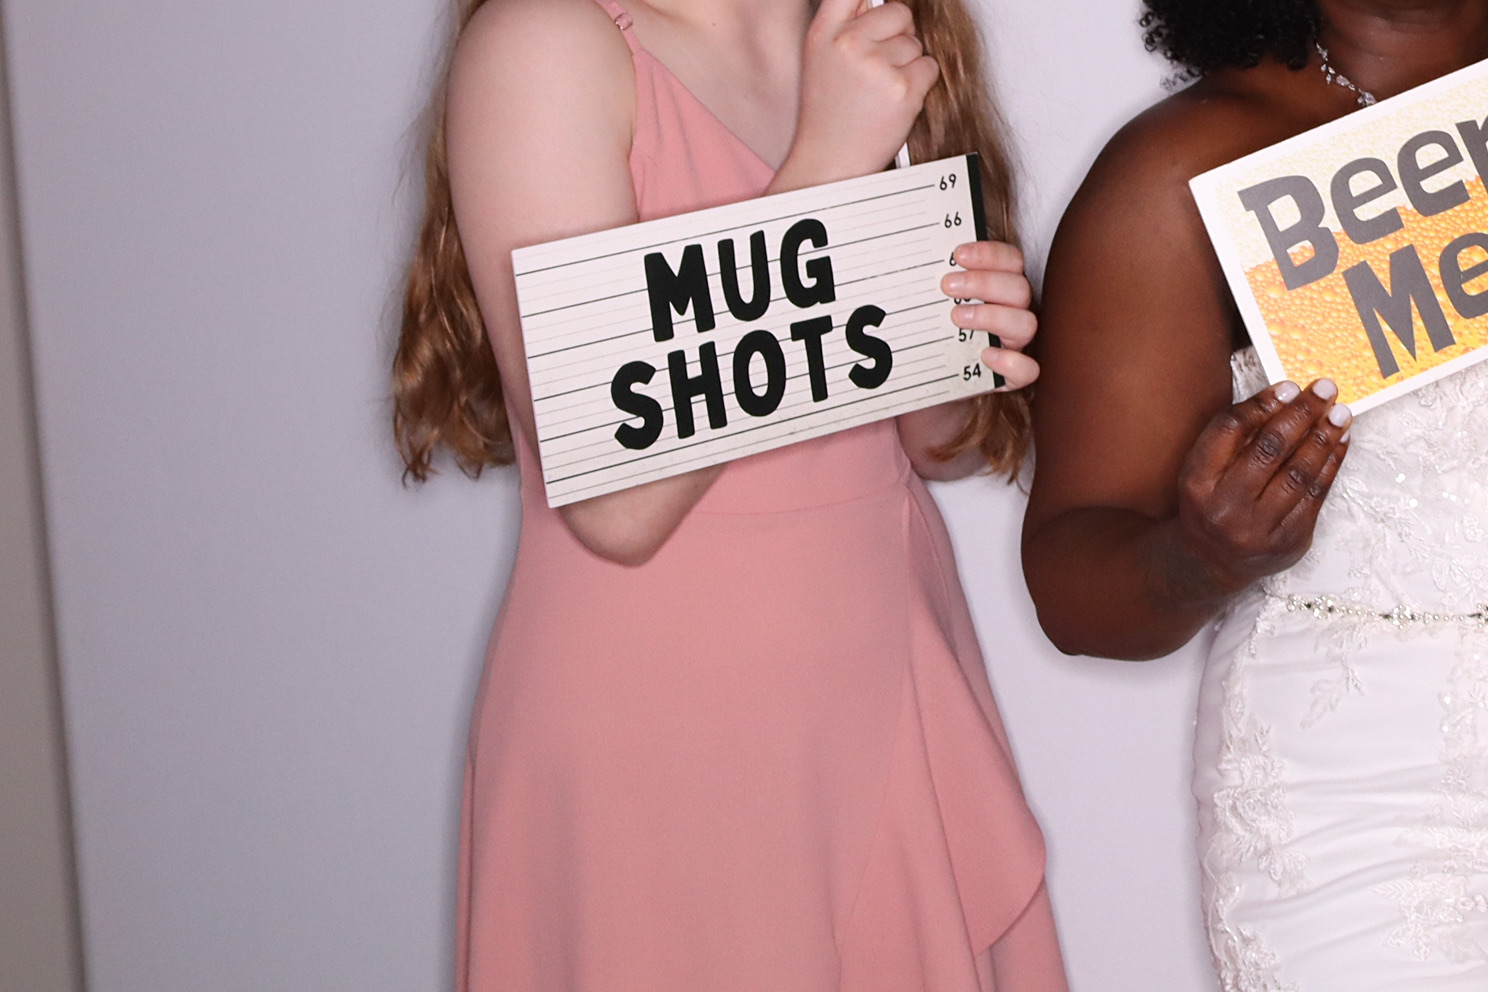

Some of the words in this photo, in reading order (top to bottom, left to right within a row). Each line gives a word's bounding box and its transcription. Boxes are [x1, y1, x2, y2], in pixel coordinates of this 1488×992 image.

[939, 173, 957, 191] 69
[944, 211, 962, 229] 66
[644, 218, 835, 342] MUG
[611, 304, 893, 450] SHOTS
[963, 363, 982, 381] 54
